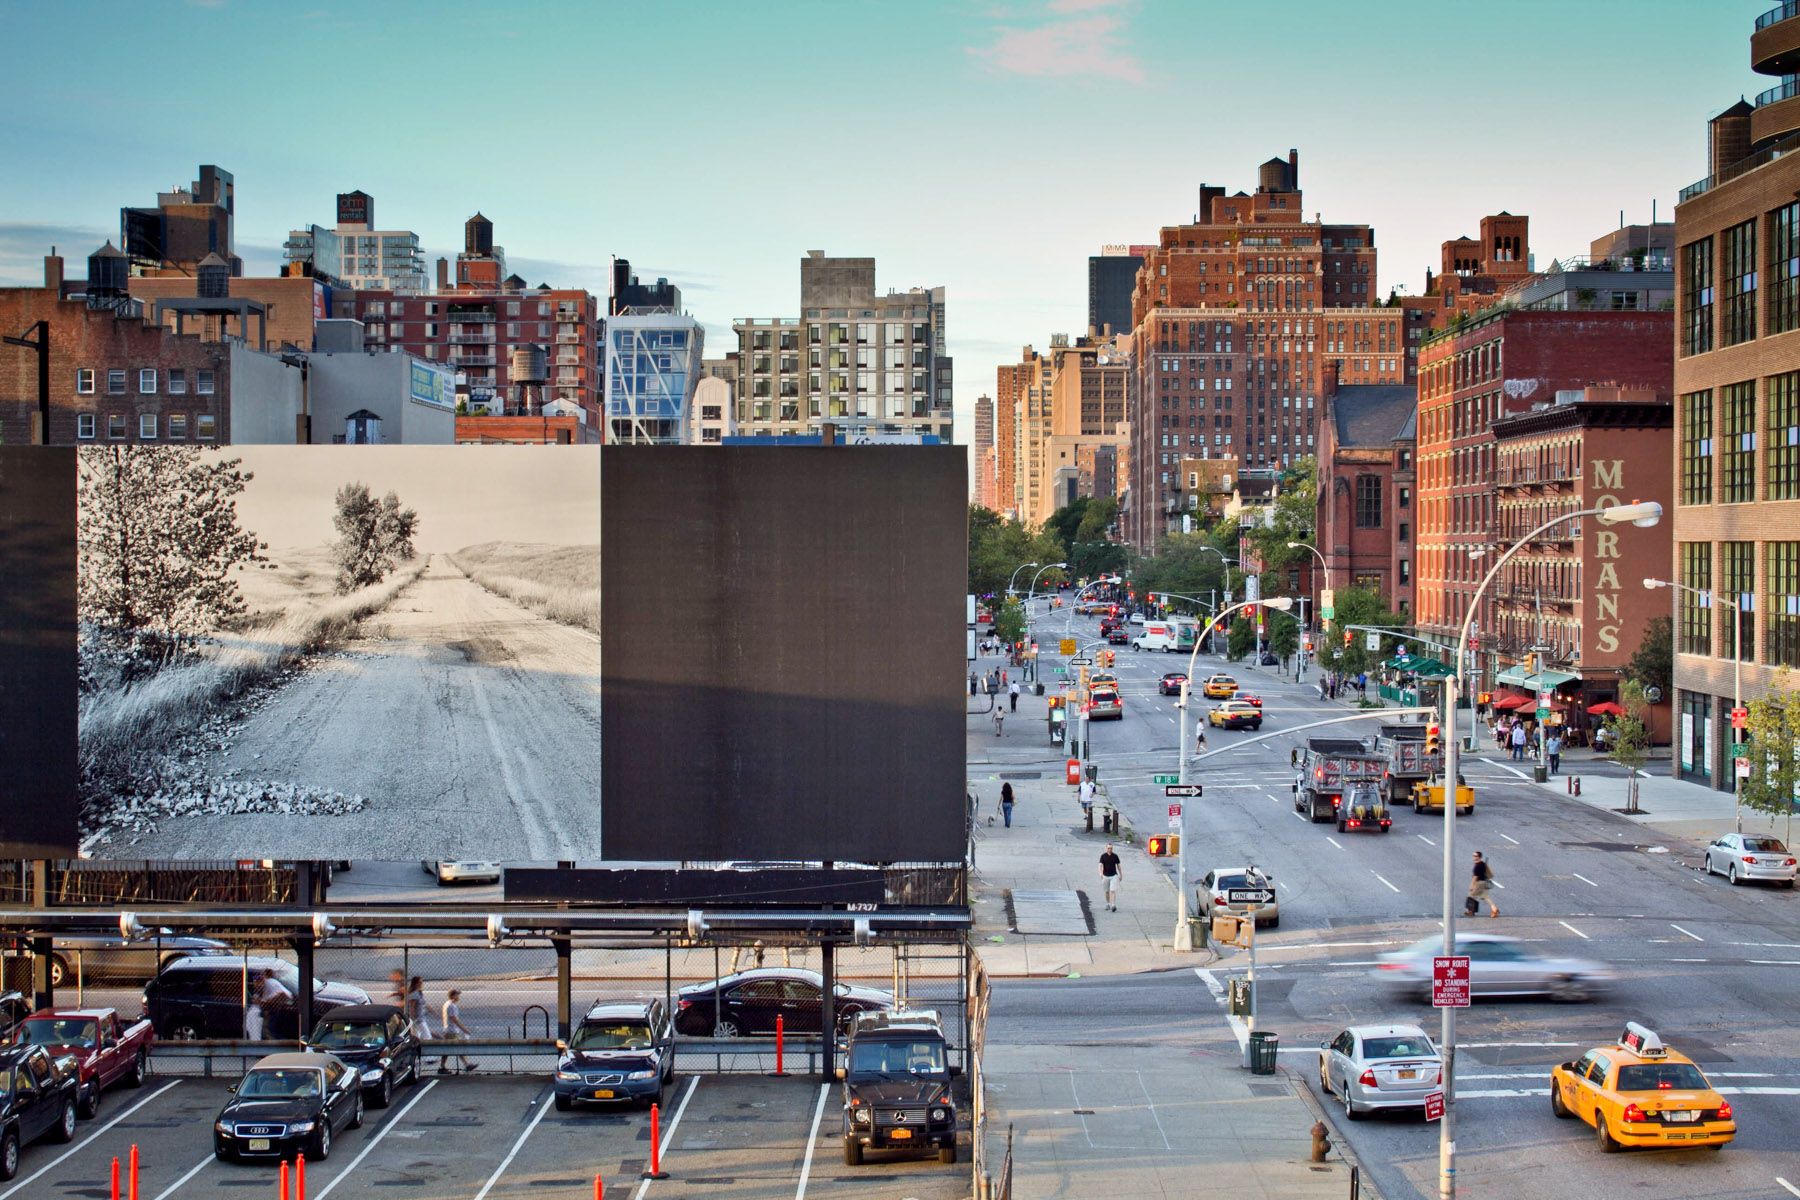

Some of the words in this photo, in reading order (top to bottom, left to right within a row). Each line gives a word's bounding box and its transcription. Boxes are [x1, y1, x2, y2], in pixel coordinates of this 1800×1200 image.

[1435, 960, 1450, 968] SNOW
[1452, 960, 1468, 968] ROUTE
[1434, 979, 1443, 987] NO
[1444, 979, 1469, 987] STANDING
